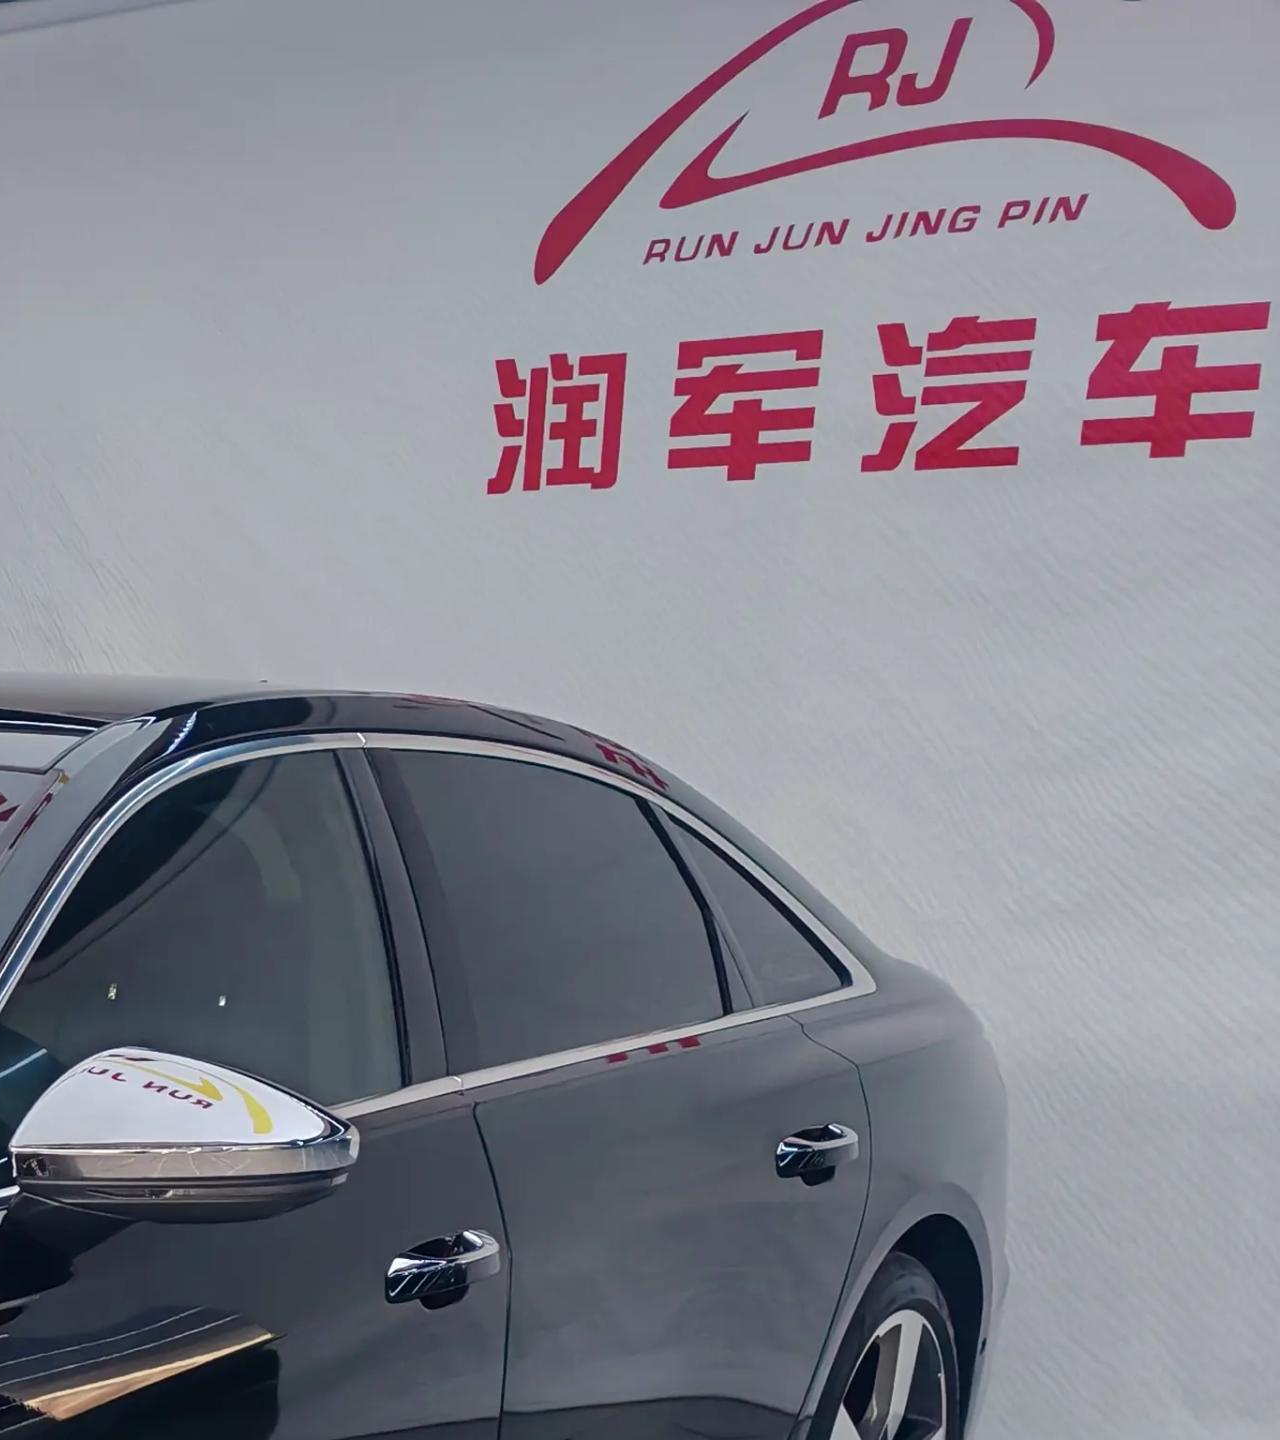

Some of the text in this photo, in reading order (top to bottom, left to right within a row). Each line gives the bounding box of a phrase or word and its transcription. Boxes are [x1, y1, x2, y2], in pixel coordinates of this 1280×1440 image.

[817, 16, 973, 120] RJ
[642, 193, 1090, 266] RUN JUN JING PIN
[486, 301, 1271, 496] 润军汽车
